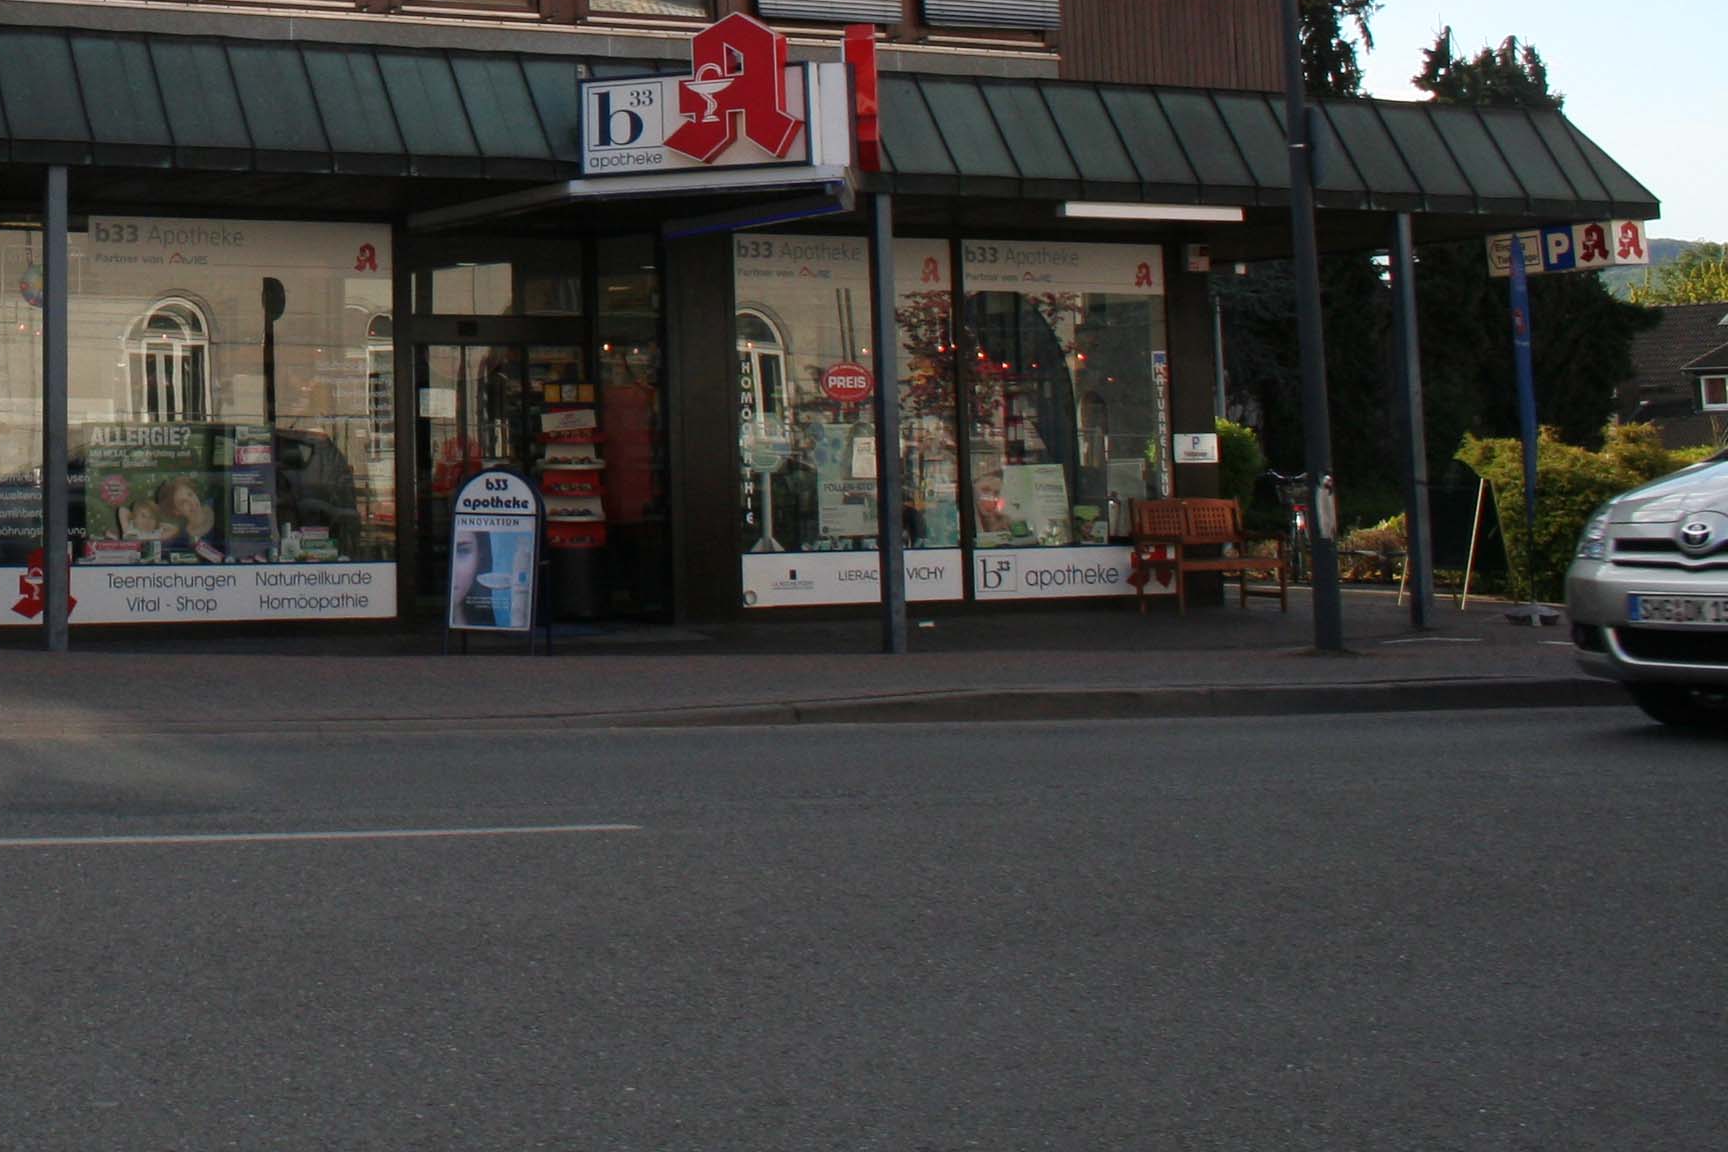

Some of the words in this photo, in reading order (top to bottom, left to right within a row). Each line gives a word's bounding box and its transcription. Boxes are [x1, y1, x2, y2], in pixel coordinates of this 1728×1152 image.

[589, 152, 663, 170] apotheke
[96, 223, 138, 243] b33
[148, 223, 244, 248] Apotheke
[736, 239, 774, 259] b33
[781, 242, 863, 262] Apotheke
[965, 245, 999, 264] b33
[1005, 247, 1079, 267] Apotheke
[1546, 232, 1570, 264] P
[828, 375, 866, 389] PREIS
[90, 426, 192, 447] ALLERGIE?
[1156, 365, 1169, 499] NATURHEILKU
[485, 478, 508, 491] b33
[462, 495, 529, 511] apotheke
[107, 572, 237, 591] Teemischungen
[255, 569, 373, 587] Naturheilkunde
[838, 570, 878, 581] LIERAC
[906, 567, 944, 580] VICHY
[1025, 564, 1119, 591] apotheke
[126, 595, 159, 613] Vital
[176, 595, 218, 614] Shop
[259, 592, 369, 611] Homöopathie
